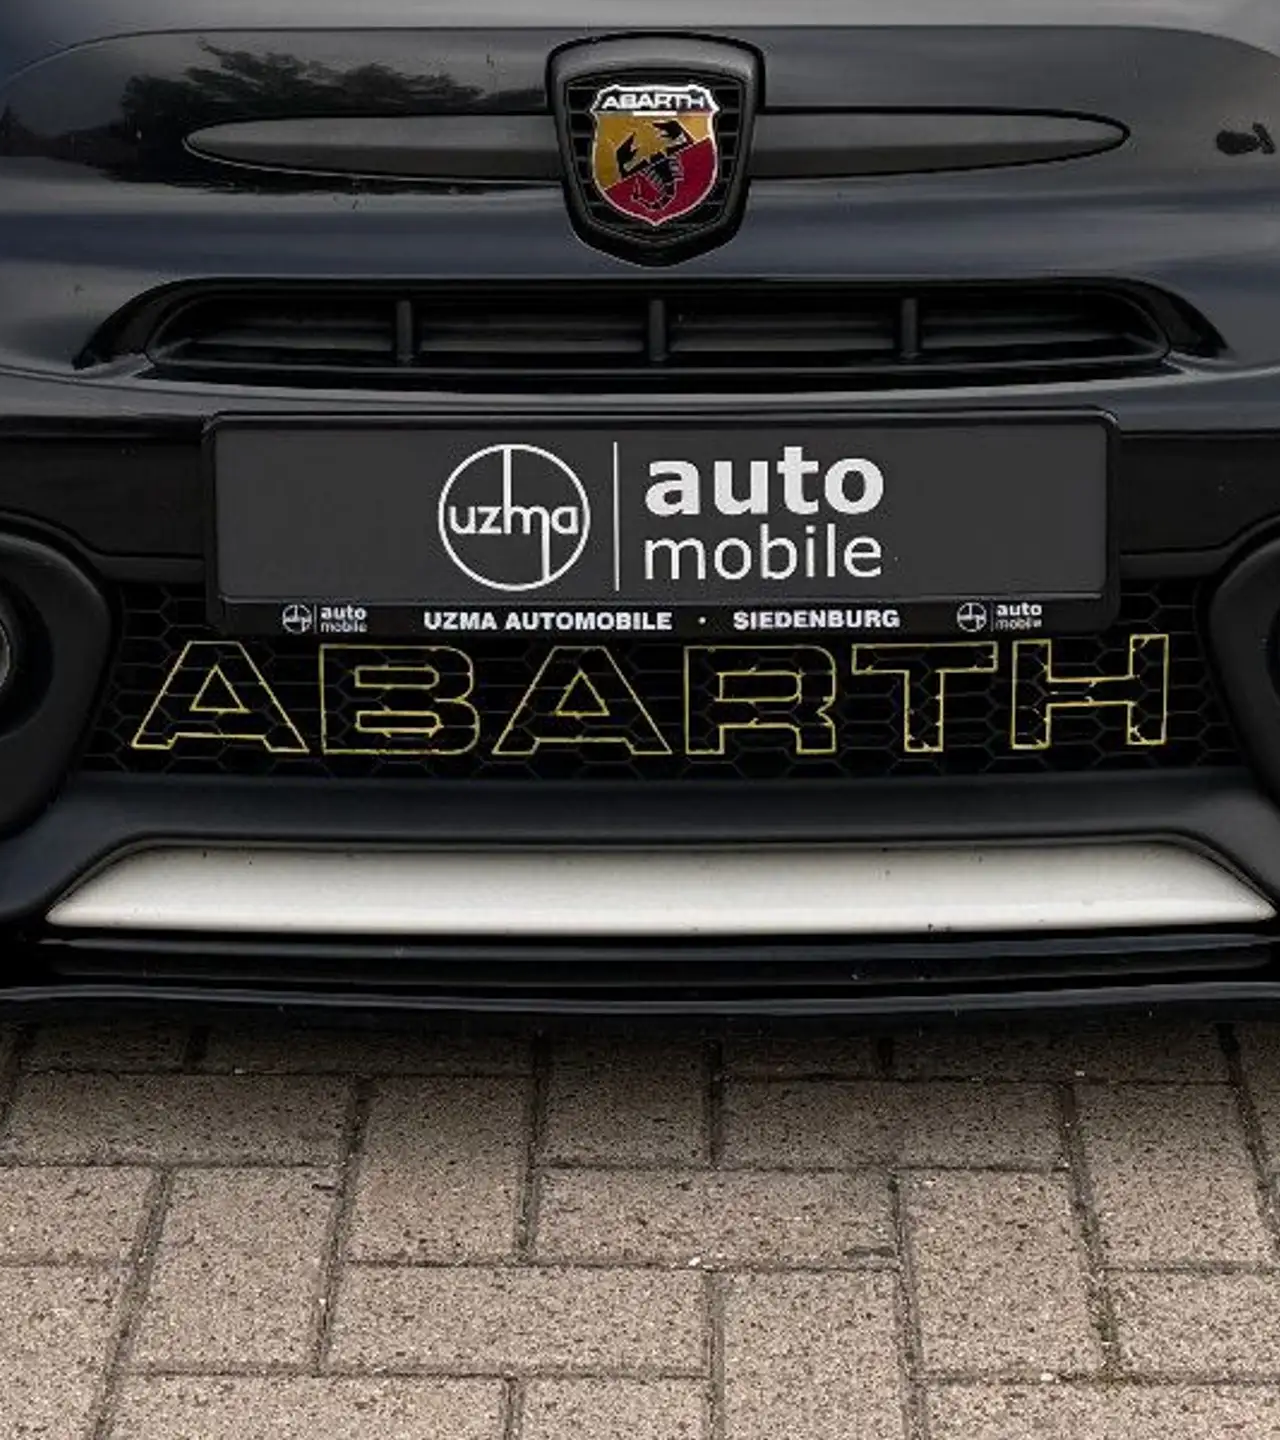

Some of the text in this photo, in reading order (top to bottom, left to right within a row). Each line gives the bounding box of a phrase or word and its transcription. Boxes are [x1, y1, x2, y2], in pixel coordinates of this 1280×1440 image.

[601, 92, 704, 110] ABARTH
[644, 446, 885, 516] auto
[644, 523, 883, 580] mobile
[320, 605, 367, 620] auto
[423, 609, 901, 631] UZMA AUTOMOBILE SIEDENBURG
[996, 602, 1043, 616] auto
[131, 634, 1170, 755] ABARTH
